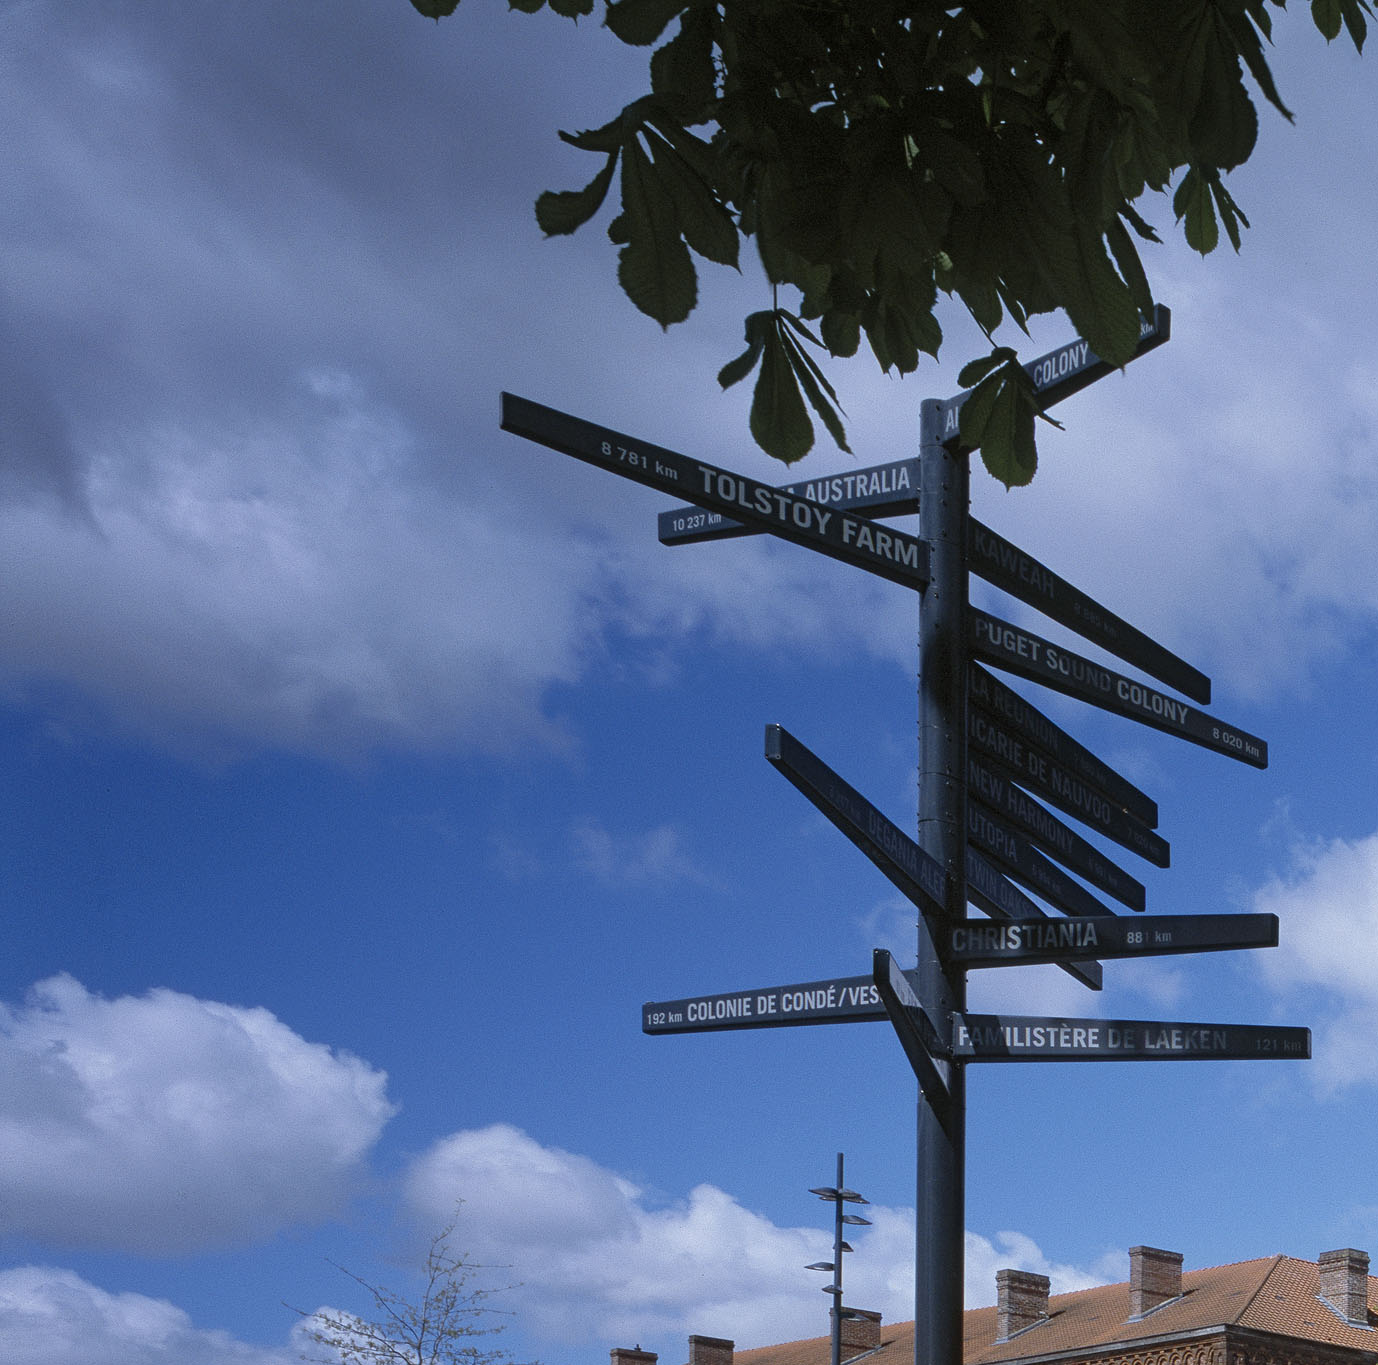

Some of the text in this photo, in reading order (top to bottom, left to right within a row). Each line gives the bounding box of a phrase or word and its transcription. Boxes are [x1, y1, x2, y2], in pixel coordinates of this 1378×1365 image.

[1033, 340, 1089, 388] COLONY
[602, 441, 919, 569] 8 781 km TOLSTOY FARM
[673, 519, 685, 532] 10
[687, 514, 706, 529] 237
[708, 513, 722, 526] km
[806, 466, 911, 504] AUSTRALIA
[974, 527, 1054, 599] KAWEAH
[975, 616, 1041, 662] PUGET
[1045, 648, 1111, 692] SOUND
[1117, 680, 1188, 725] COLONY
[1212, 727, 1220, 740] 8
[1222, 732, 1243, 749] 020
[1245, 741, 1260, 758] km
[971, 713, 1022, 768] ICARIE
[1028, 751, 1047, 783] DE
[1052, 767, 1112, 825] NAUVOO
[969, 760, 1074, 855] NEW HARMONY
[969, 807, 1018, 863] UTOPIA
[952, 922, 1099, 952] CHRISTIANIA
[1155, 930, 1172, 943] km
[647, 1013, 666, 1025] 192
[668, 1010, 683, 1024] km
[687, 997, 752, 1022] COLONIE
[757, 995, 777, 1015] DE
[958, 1023, 1303, 1051] FAMILISTÈRE DE LAEKEN 121 km
